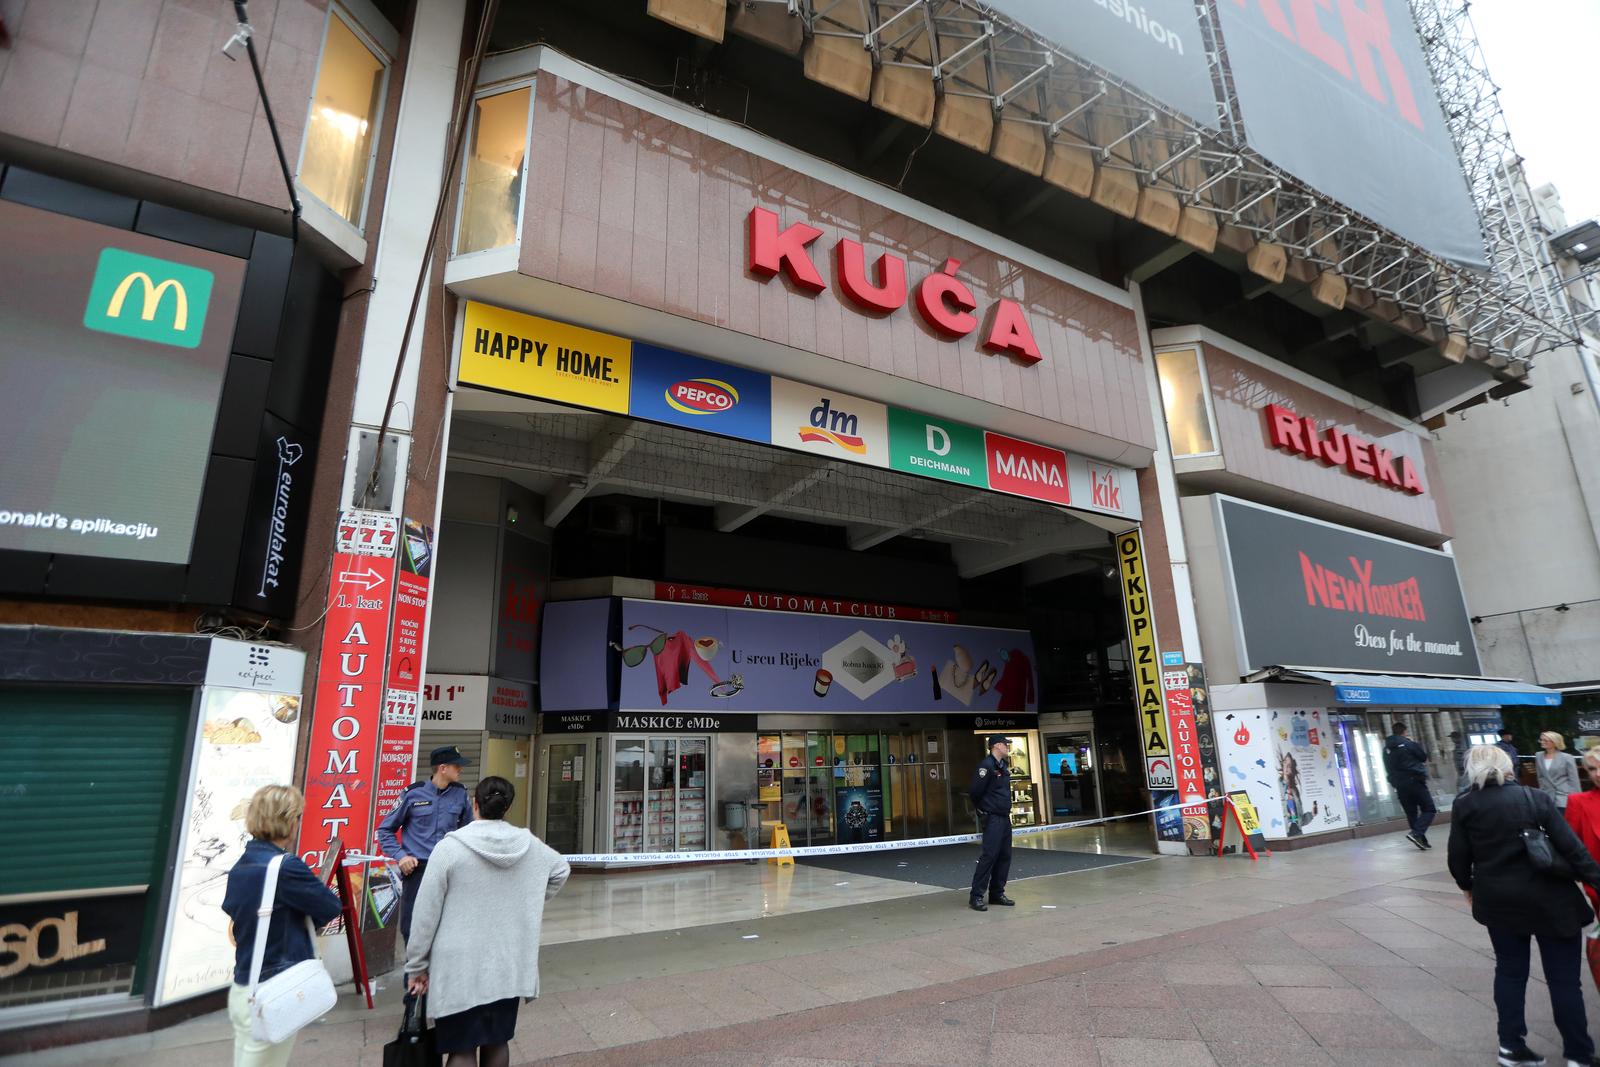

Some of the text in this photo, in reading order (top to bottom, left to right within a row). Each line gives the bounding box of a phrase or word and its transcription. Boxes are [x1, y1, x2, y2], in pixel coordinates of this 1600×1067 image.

[1093, 0, 1184, 56] shion
[744, 206, 1043, 366] KUĆA
[474, 328, 619, 384] HAPPY HOME.
[677, 385, 728, 408] PEPCO
[809, 398, 858, 436] dm
[925, 424, 951, 457] D
[1265, 403, 1425, 496] RIJEKA
[910, 455, 971, 477] DEICHMANN
[995, 450, 1064, 488] MANA
[1091, 468, 1121, 509] kik
[0, 510, 159, 540] onald's aplikaciju
[266, 471, 293, 588] europlakat
[337, 595, 384, 611] 1. kat
[743, 593, 896, 618] AUTOMAT CLUB
[401, 628, 417, 637] ULAZ
[1121, 537, 1167, 750] OTKUP ZLATA
[1354, 624, 1386, 649] Dress
[1387, 630, 1404, 656] for
[1406, 633, 1423, 653] the
[732, 650, 820, 669] U srcu Rijeke
[421, 710, 453, 721] ANGE
[561, 714, 592, 723] MASKICE
[567, 722, 585, 730] eMDe
[616, 716, 720, 729] MASKICE eMDe
[321, 621, 369, 843] AUTOMAT
[1178, 718, 1198, 793] AUTOMA
[386, 779, 405, 787] NIGHT
[1150, 776, 1173, 785] ULAZ
[1182, 807, 1207, 815] CLUB
